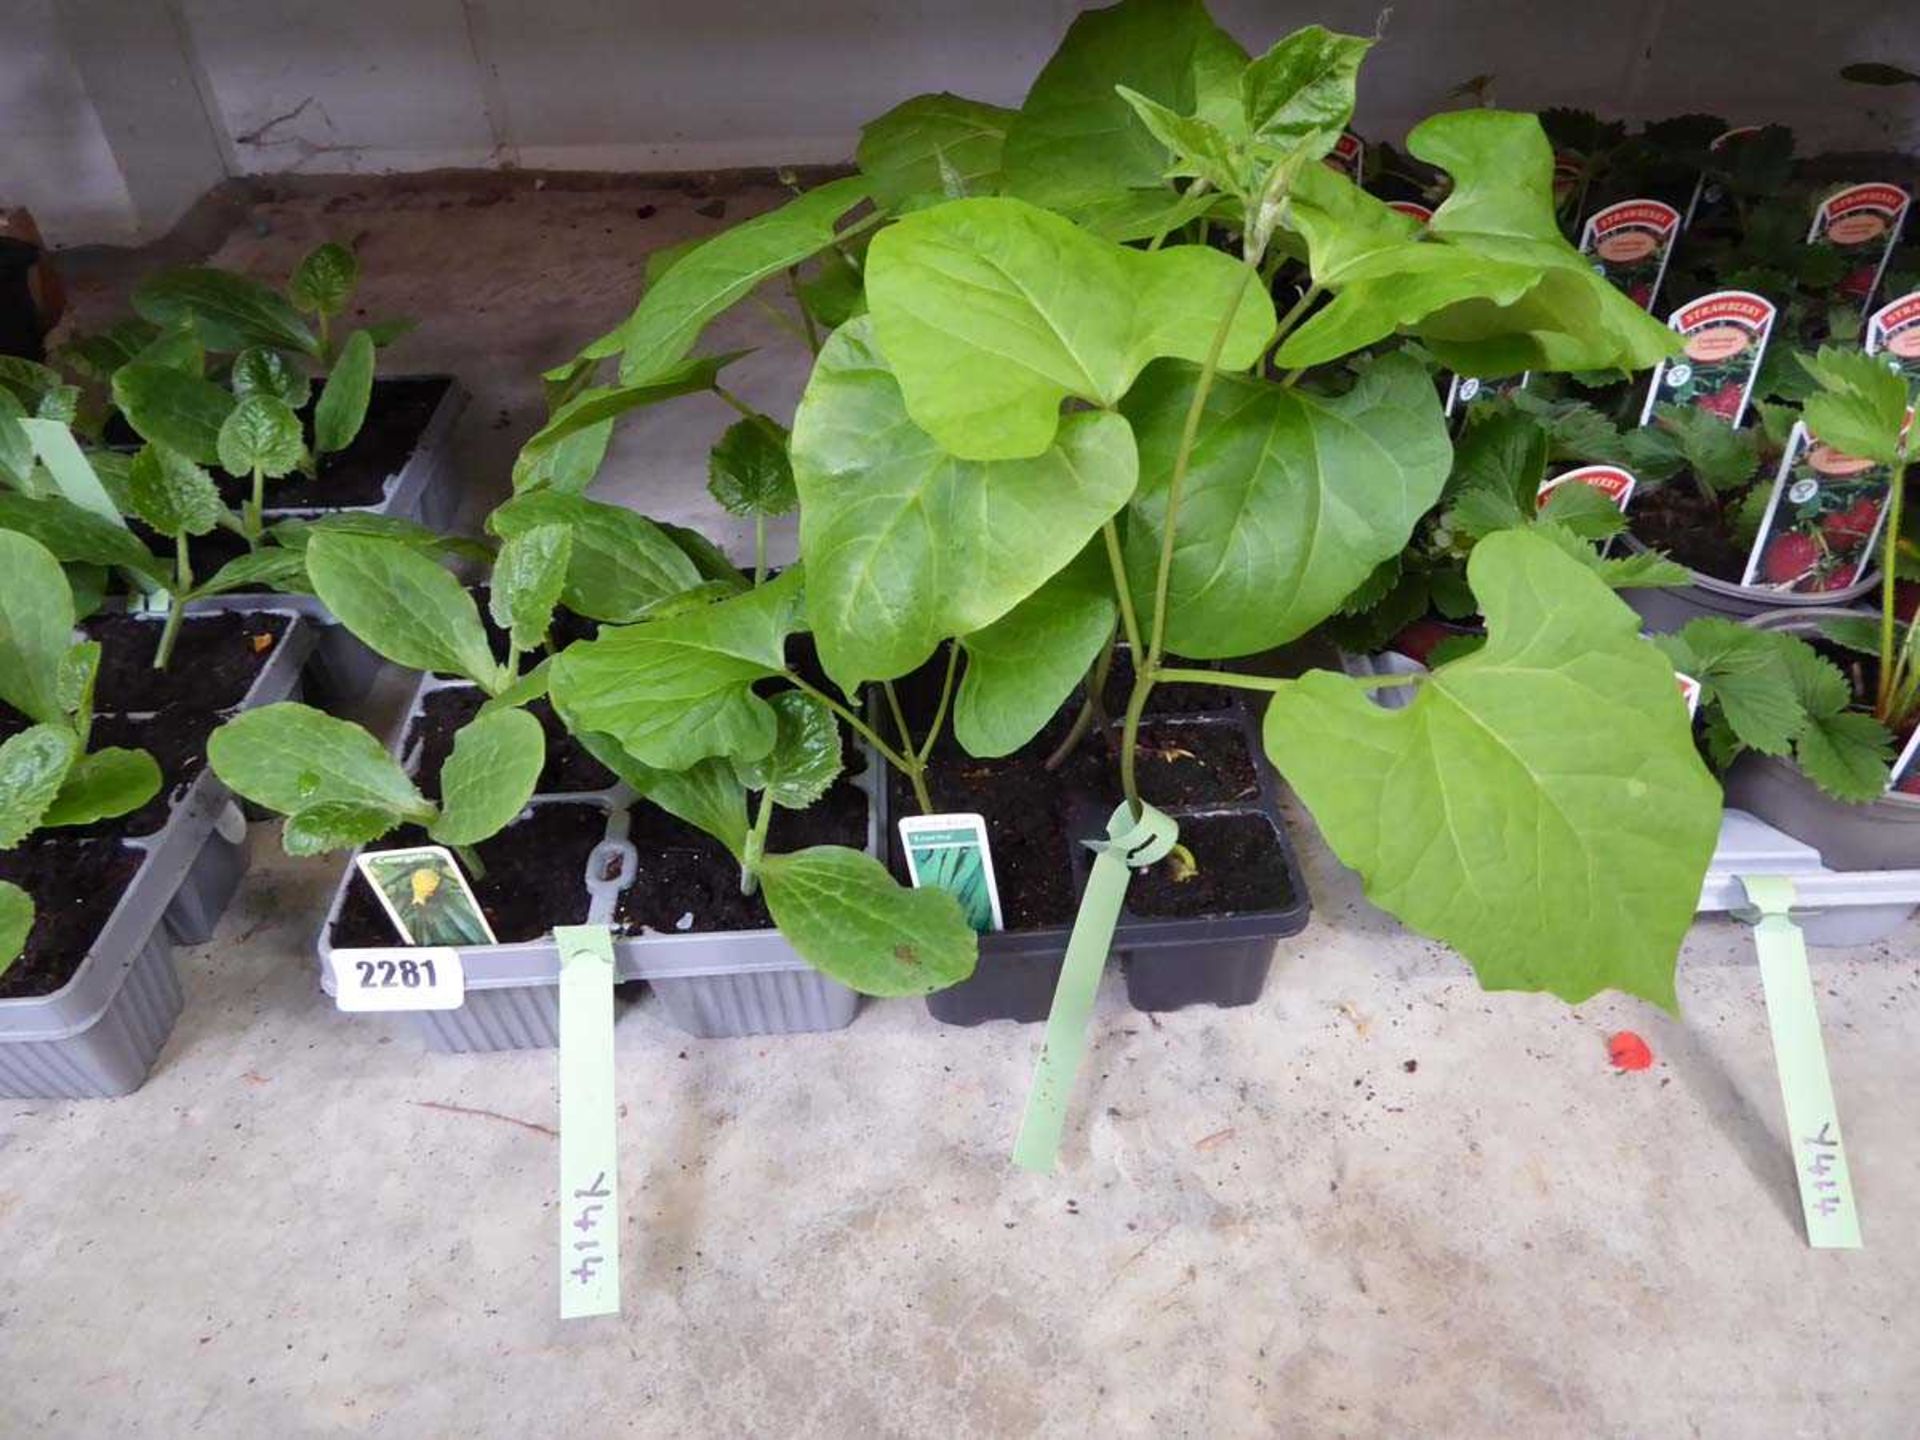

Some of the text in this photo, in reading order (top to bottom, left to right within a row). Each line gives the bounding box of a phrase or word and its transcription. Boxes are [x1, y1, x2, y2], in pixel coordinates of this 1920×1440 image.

[1600, 209, 1669, 227] STRAWBERRY
[1685, 301, 1763, 323] STRAWBERRY
[355, 959, 437, 988] 2281
[571, 1170, 612, 1285] Y414
